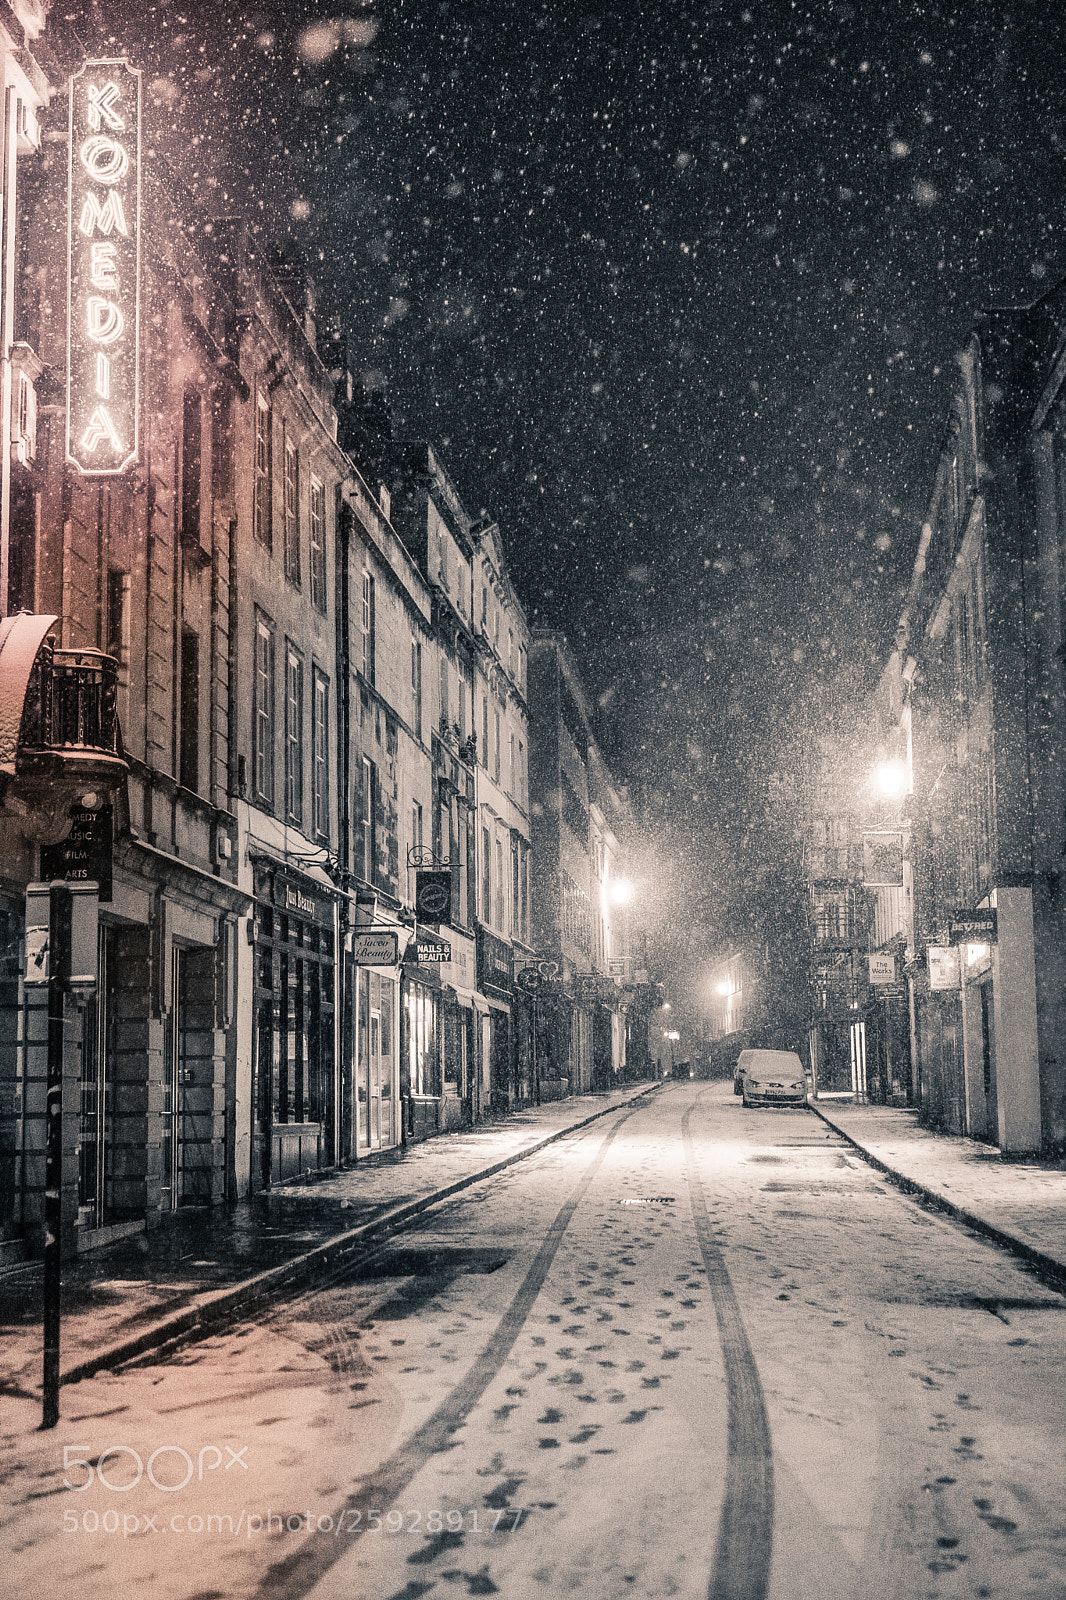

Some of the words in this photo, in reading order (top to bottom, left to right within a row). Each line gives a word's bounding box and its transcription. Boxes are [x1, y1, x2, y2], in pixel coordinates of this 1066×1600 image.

[79, 82, 128, 453] KOMEDIA
[69, 813, 97, 821] MEDY
[65, 869, 88, 878] ARTS
[952, 921, 993, 931] BETFRED
[355, 947, 393, 960] Beauty
[417, 945, 442, 953] NAILS
[444, 945, 450, 953] &
[418, 953, 450, 961] BEAUTY
